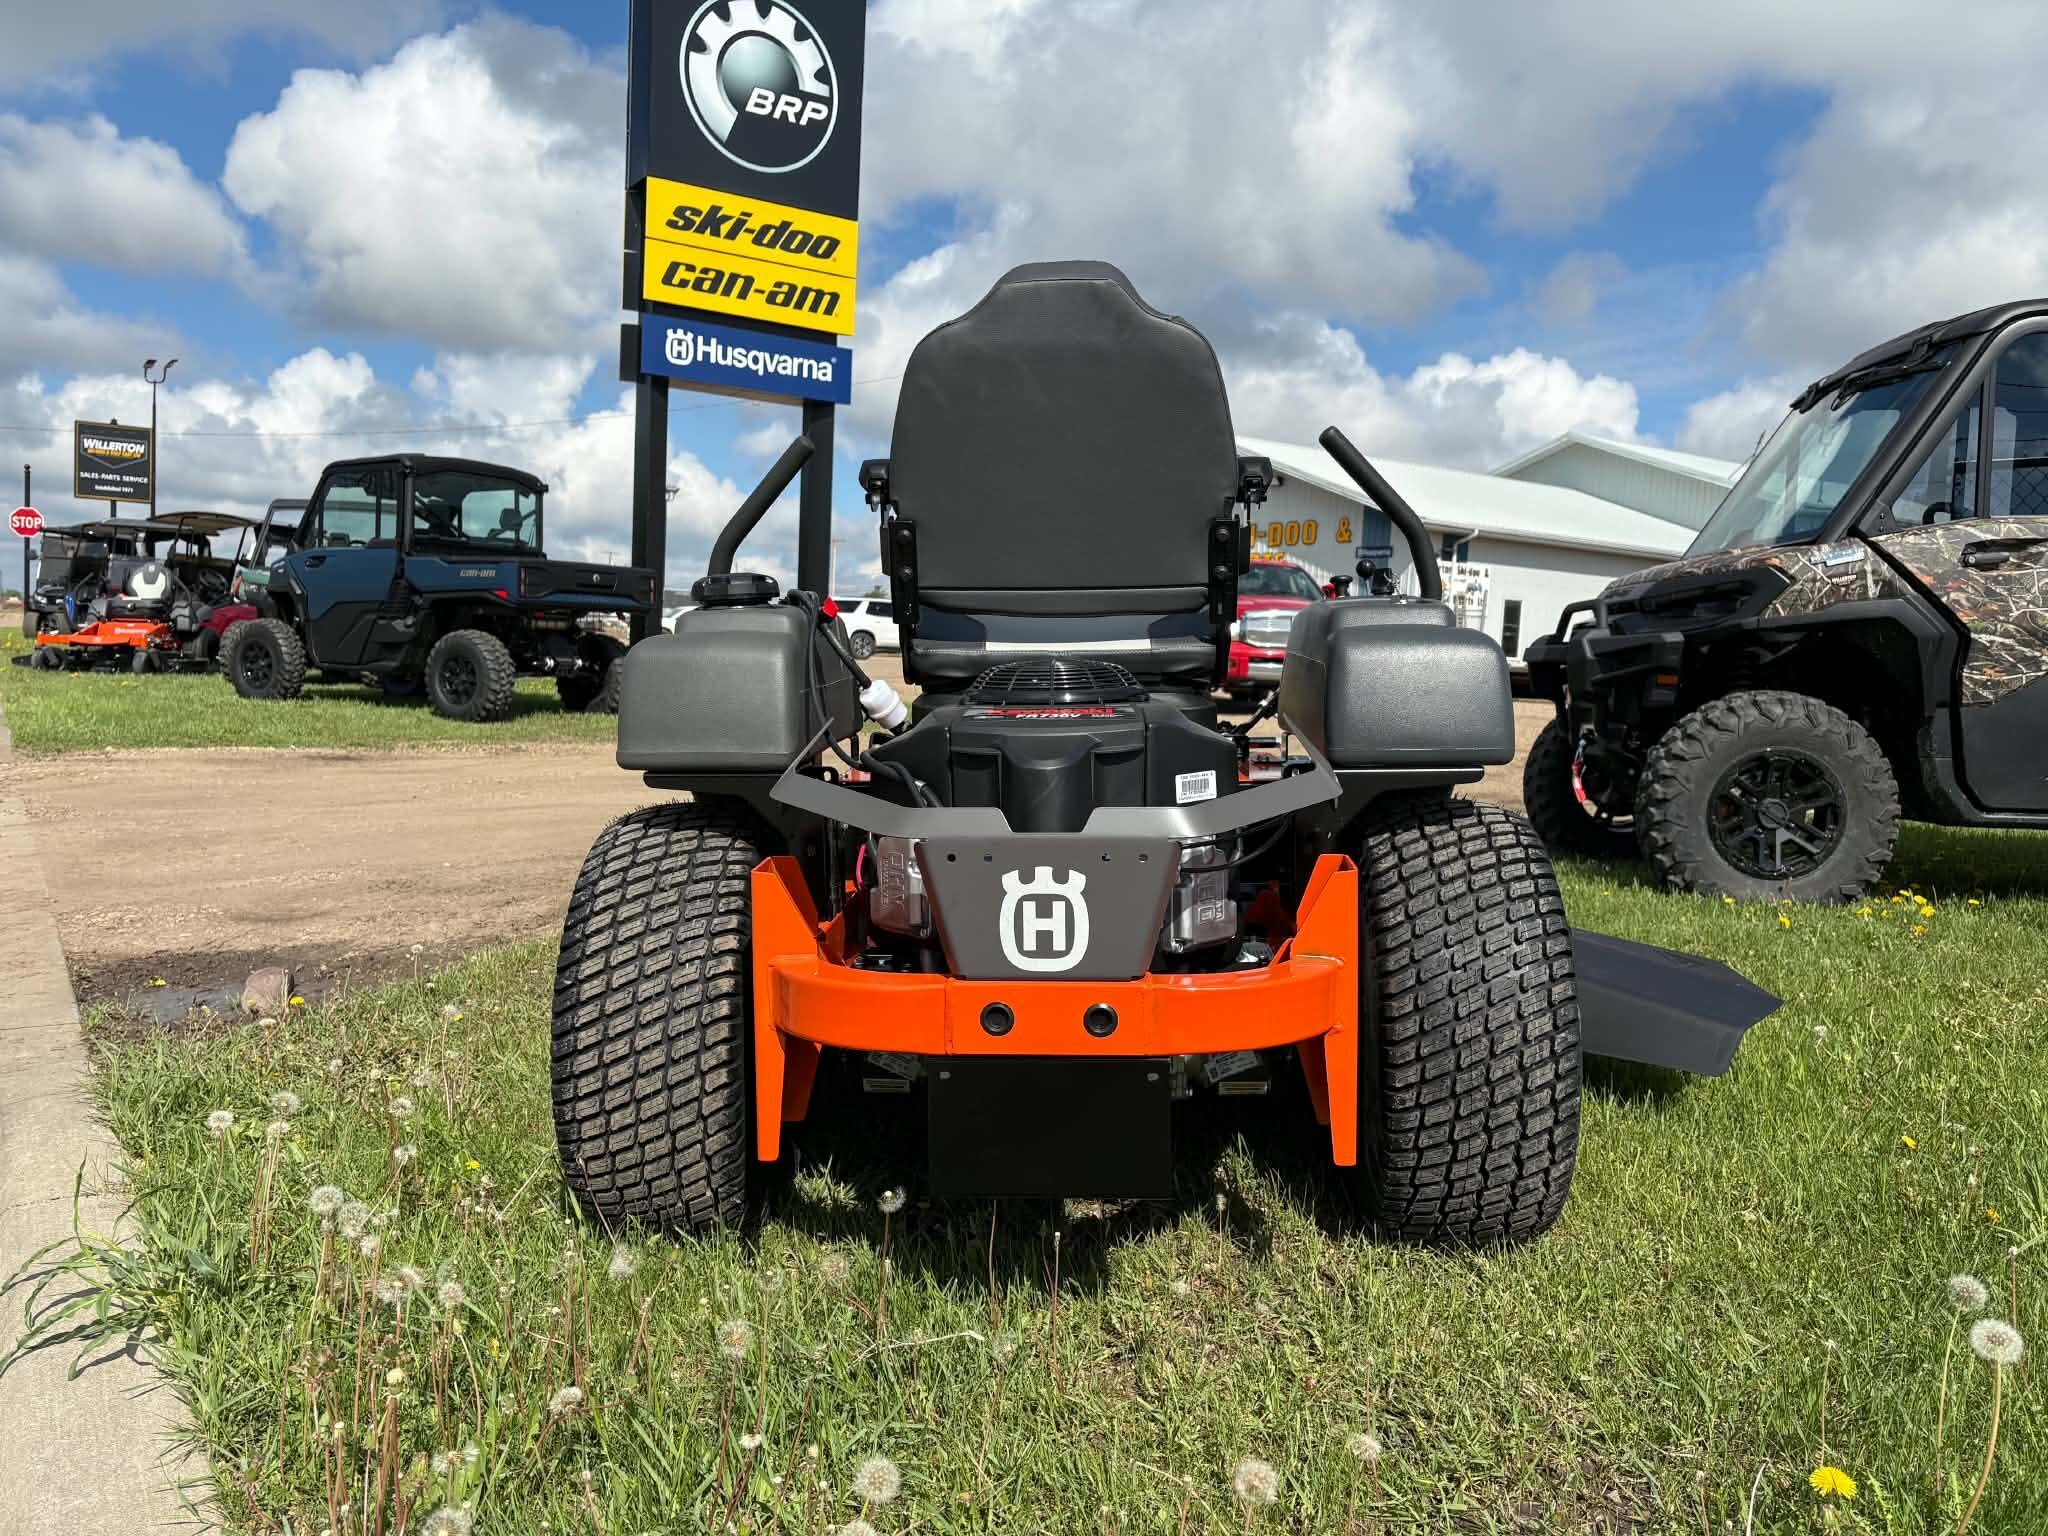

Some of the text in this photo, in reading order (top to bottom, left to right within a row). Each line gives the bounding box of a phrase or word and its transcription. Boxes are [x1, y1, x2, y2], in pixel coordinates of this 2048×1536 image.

[745, 87, 829, 126] BRP
[665, 204, 841, 260] ski-doo
[661, 261, 841, 316] can-am
[697, 335, 833, 382] Husqvarna
[83, 438, 145, 454] WILLERTON
[12, 515, 42, 528] STOP
[1335, 515, 1352, 544] &
